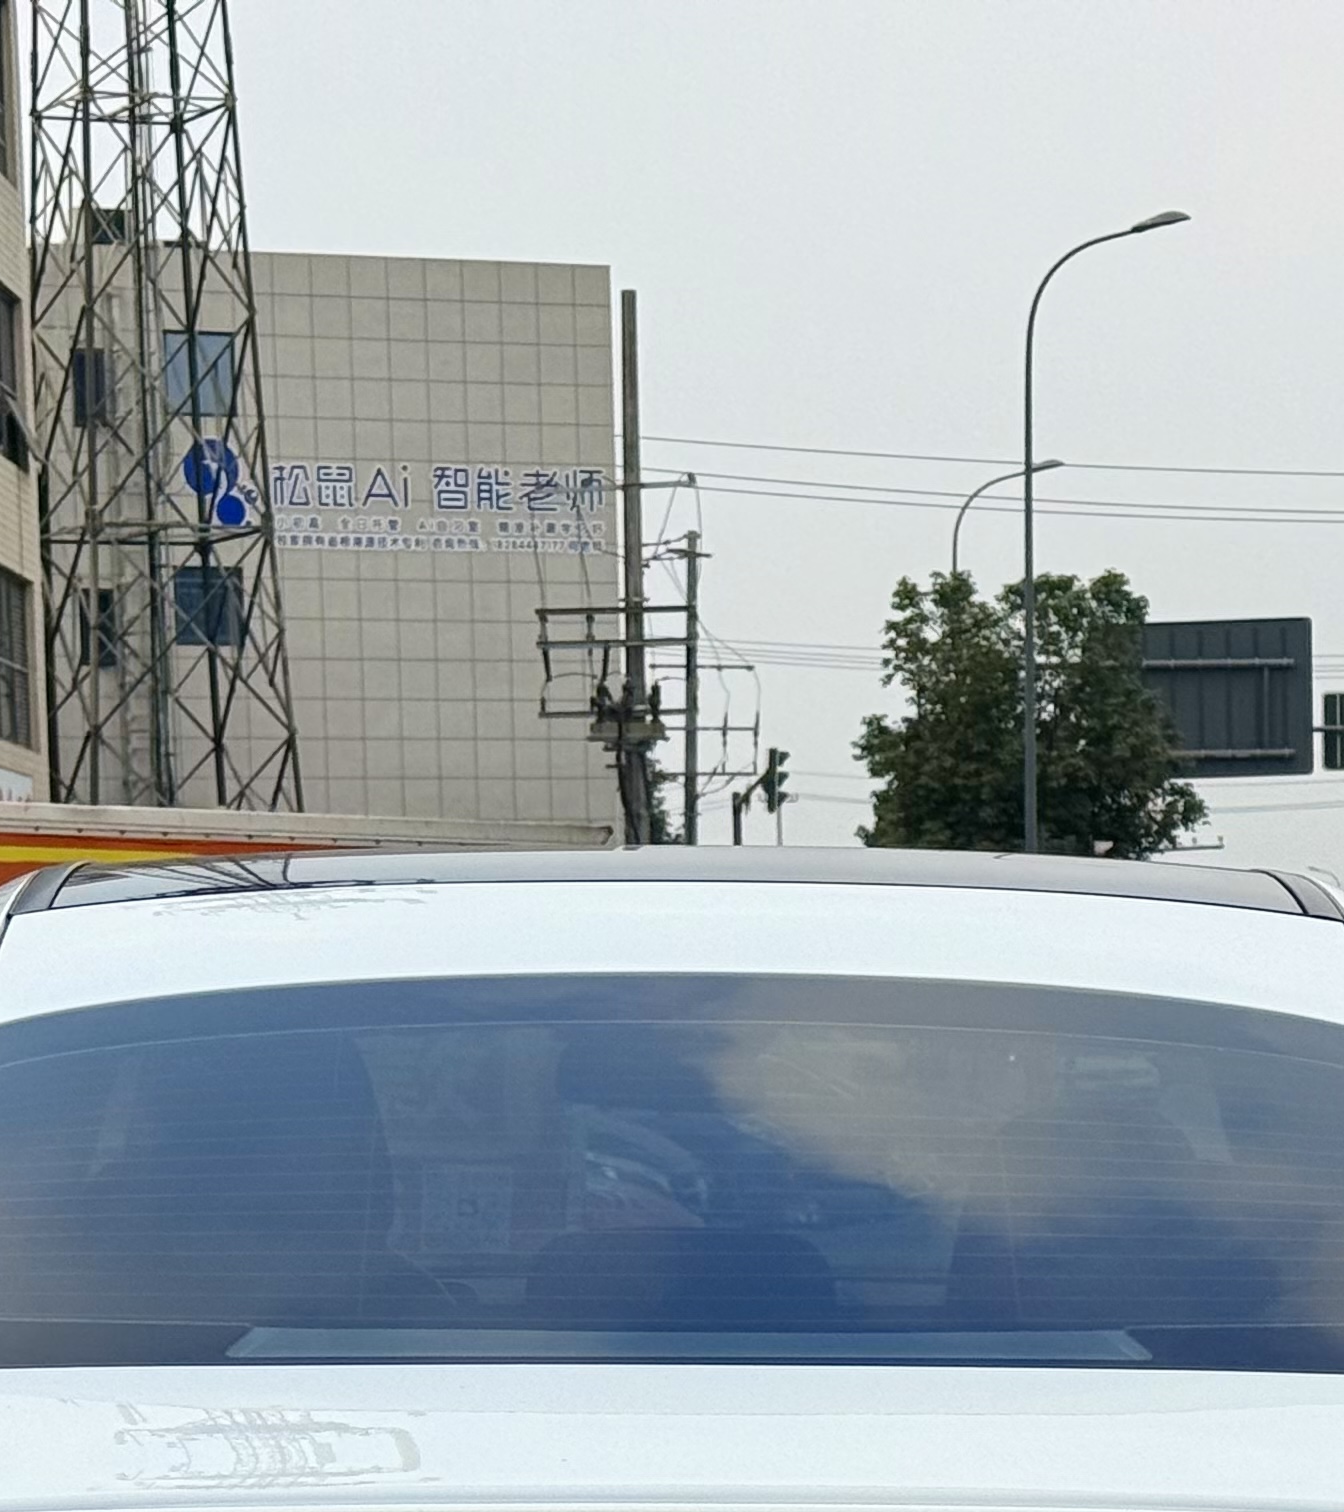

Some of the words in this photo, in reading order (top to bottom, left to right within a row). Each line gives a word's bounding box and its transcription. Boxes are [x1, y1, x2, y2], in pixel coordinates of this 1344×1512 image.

[271, 463, 411, 509] 松鼠Ai
[433, 465, 606, 513] 智能老师
